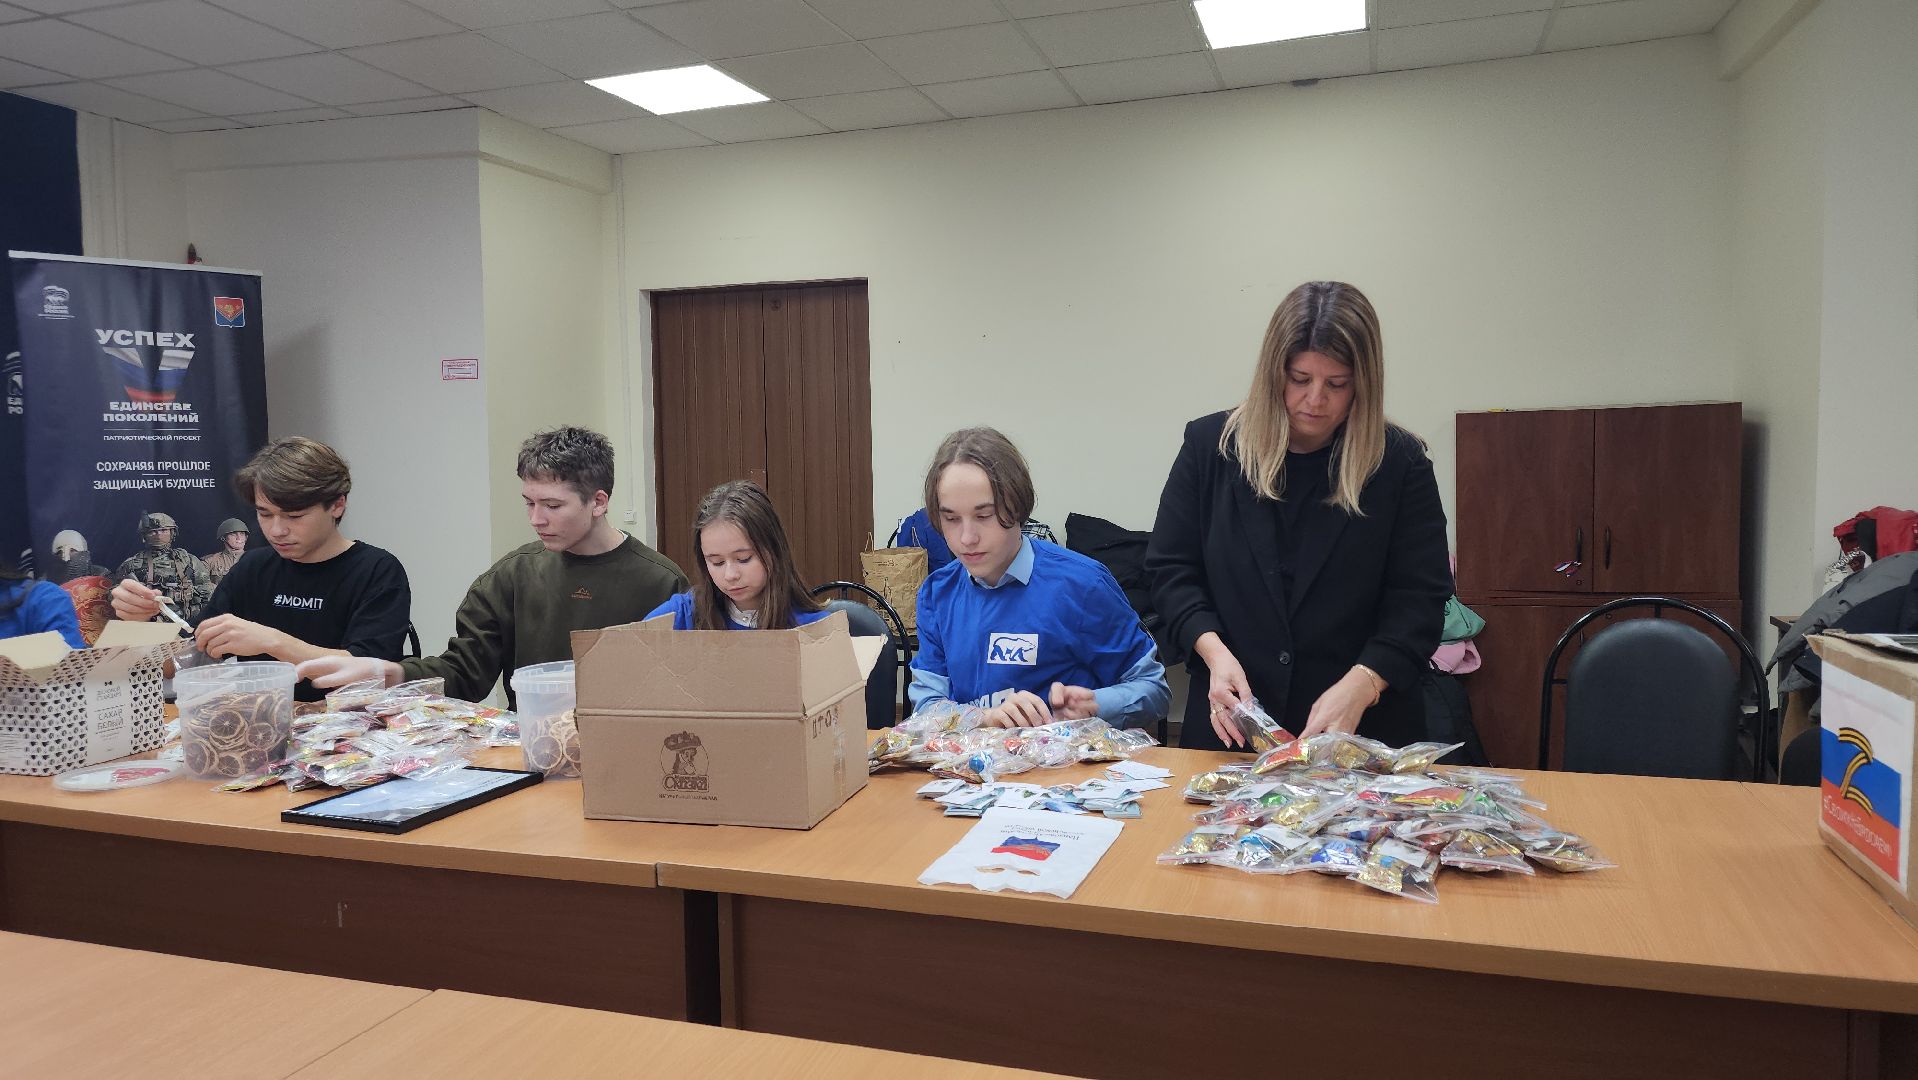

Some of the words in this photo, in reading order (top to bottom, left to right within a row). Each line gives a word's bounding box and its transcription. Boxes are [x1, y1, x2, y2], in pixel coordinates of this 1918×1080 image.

[95, 328, 196, 348] УСПЕХ
[109, 401, 192, 411] ЕДИНСТВЕ
[103, 412, 199, 423] ПОКОЛЕНИЙ
[96, 460, 154, 472] СОХРАНЯЯ
[157, 461, 211, 471] ПРОШЛОЕ
[93, 479, 163, 491] ЗАЩИЩАЕМ
[165, 478, 216, 490] БУДУЩЕЕ
